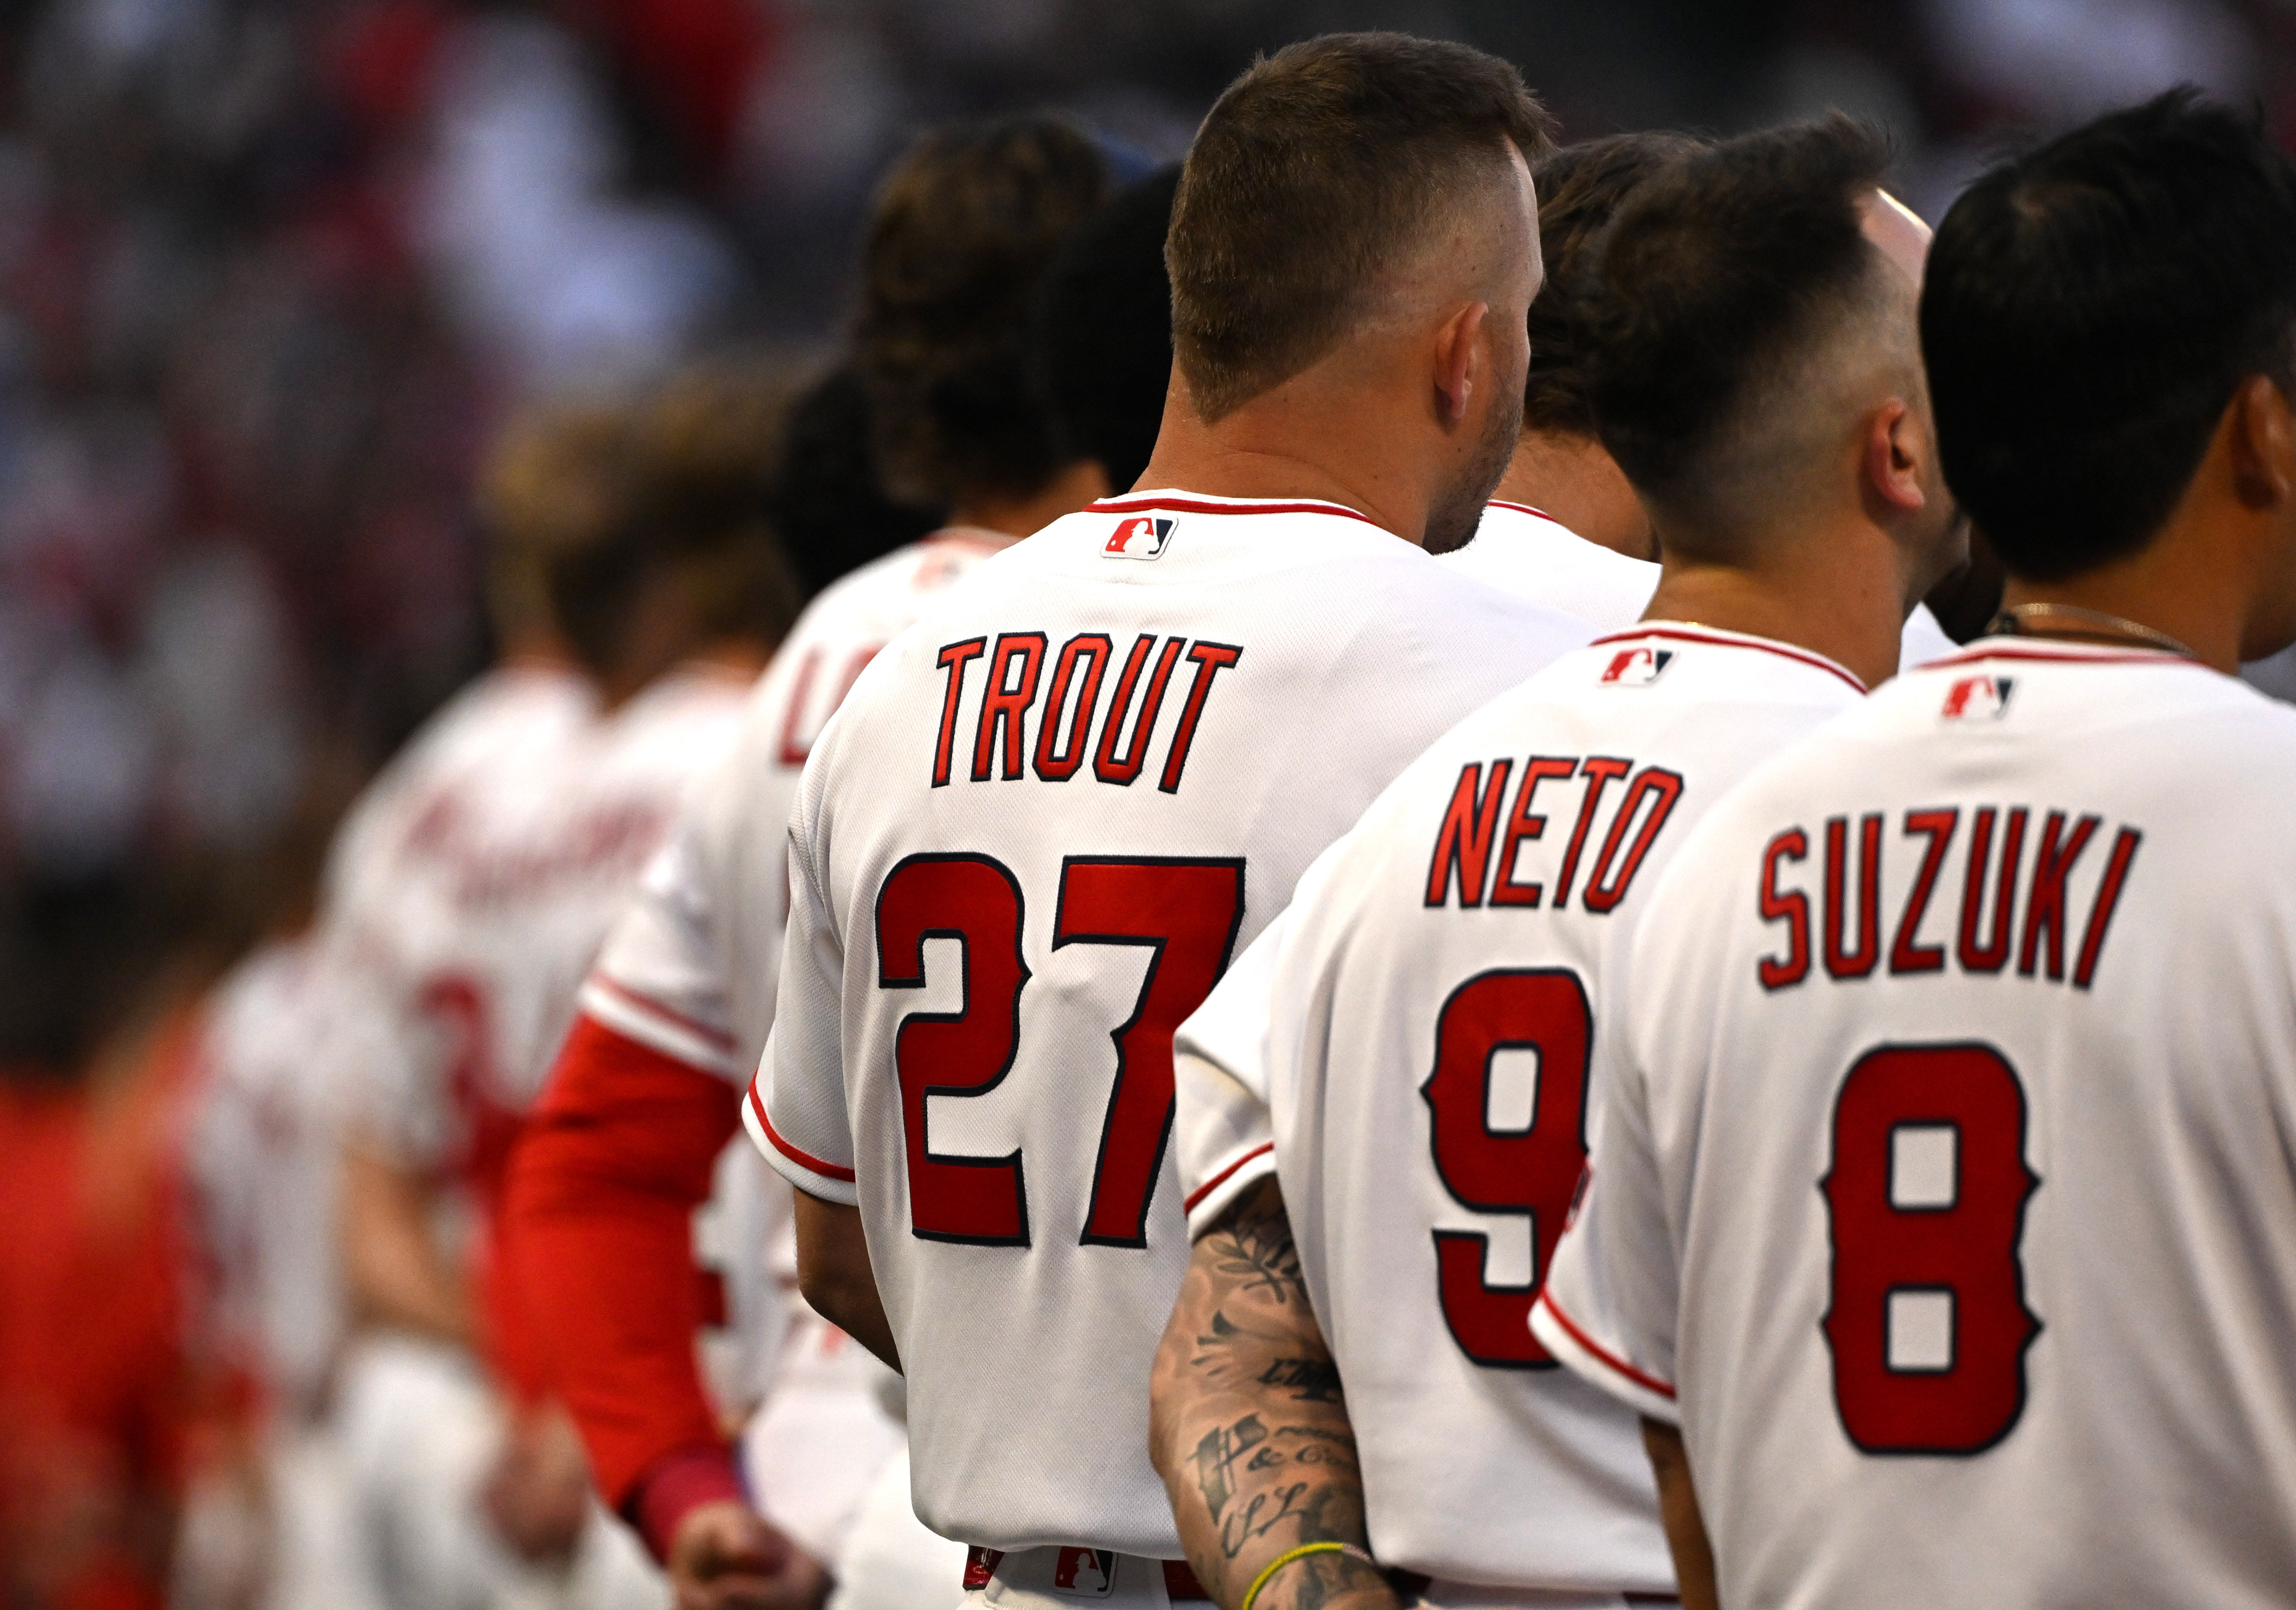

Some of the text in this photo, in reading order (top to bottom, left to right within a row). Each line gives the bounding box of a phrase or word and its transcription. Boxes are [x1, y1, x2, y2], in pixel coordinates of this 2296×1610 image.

[931, 631, 1244, 794] TROUT
[1424, 755, 1685, 915] NETO
[1757, 805, 2144, 992] SUZUKI
[875, 852, 1246, 1248] 27
[1420, 966, 1593, 1370] 9
[1817, 1039, 2044, 1458] 8
